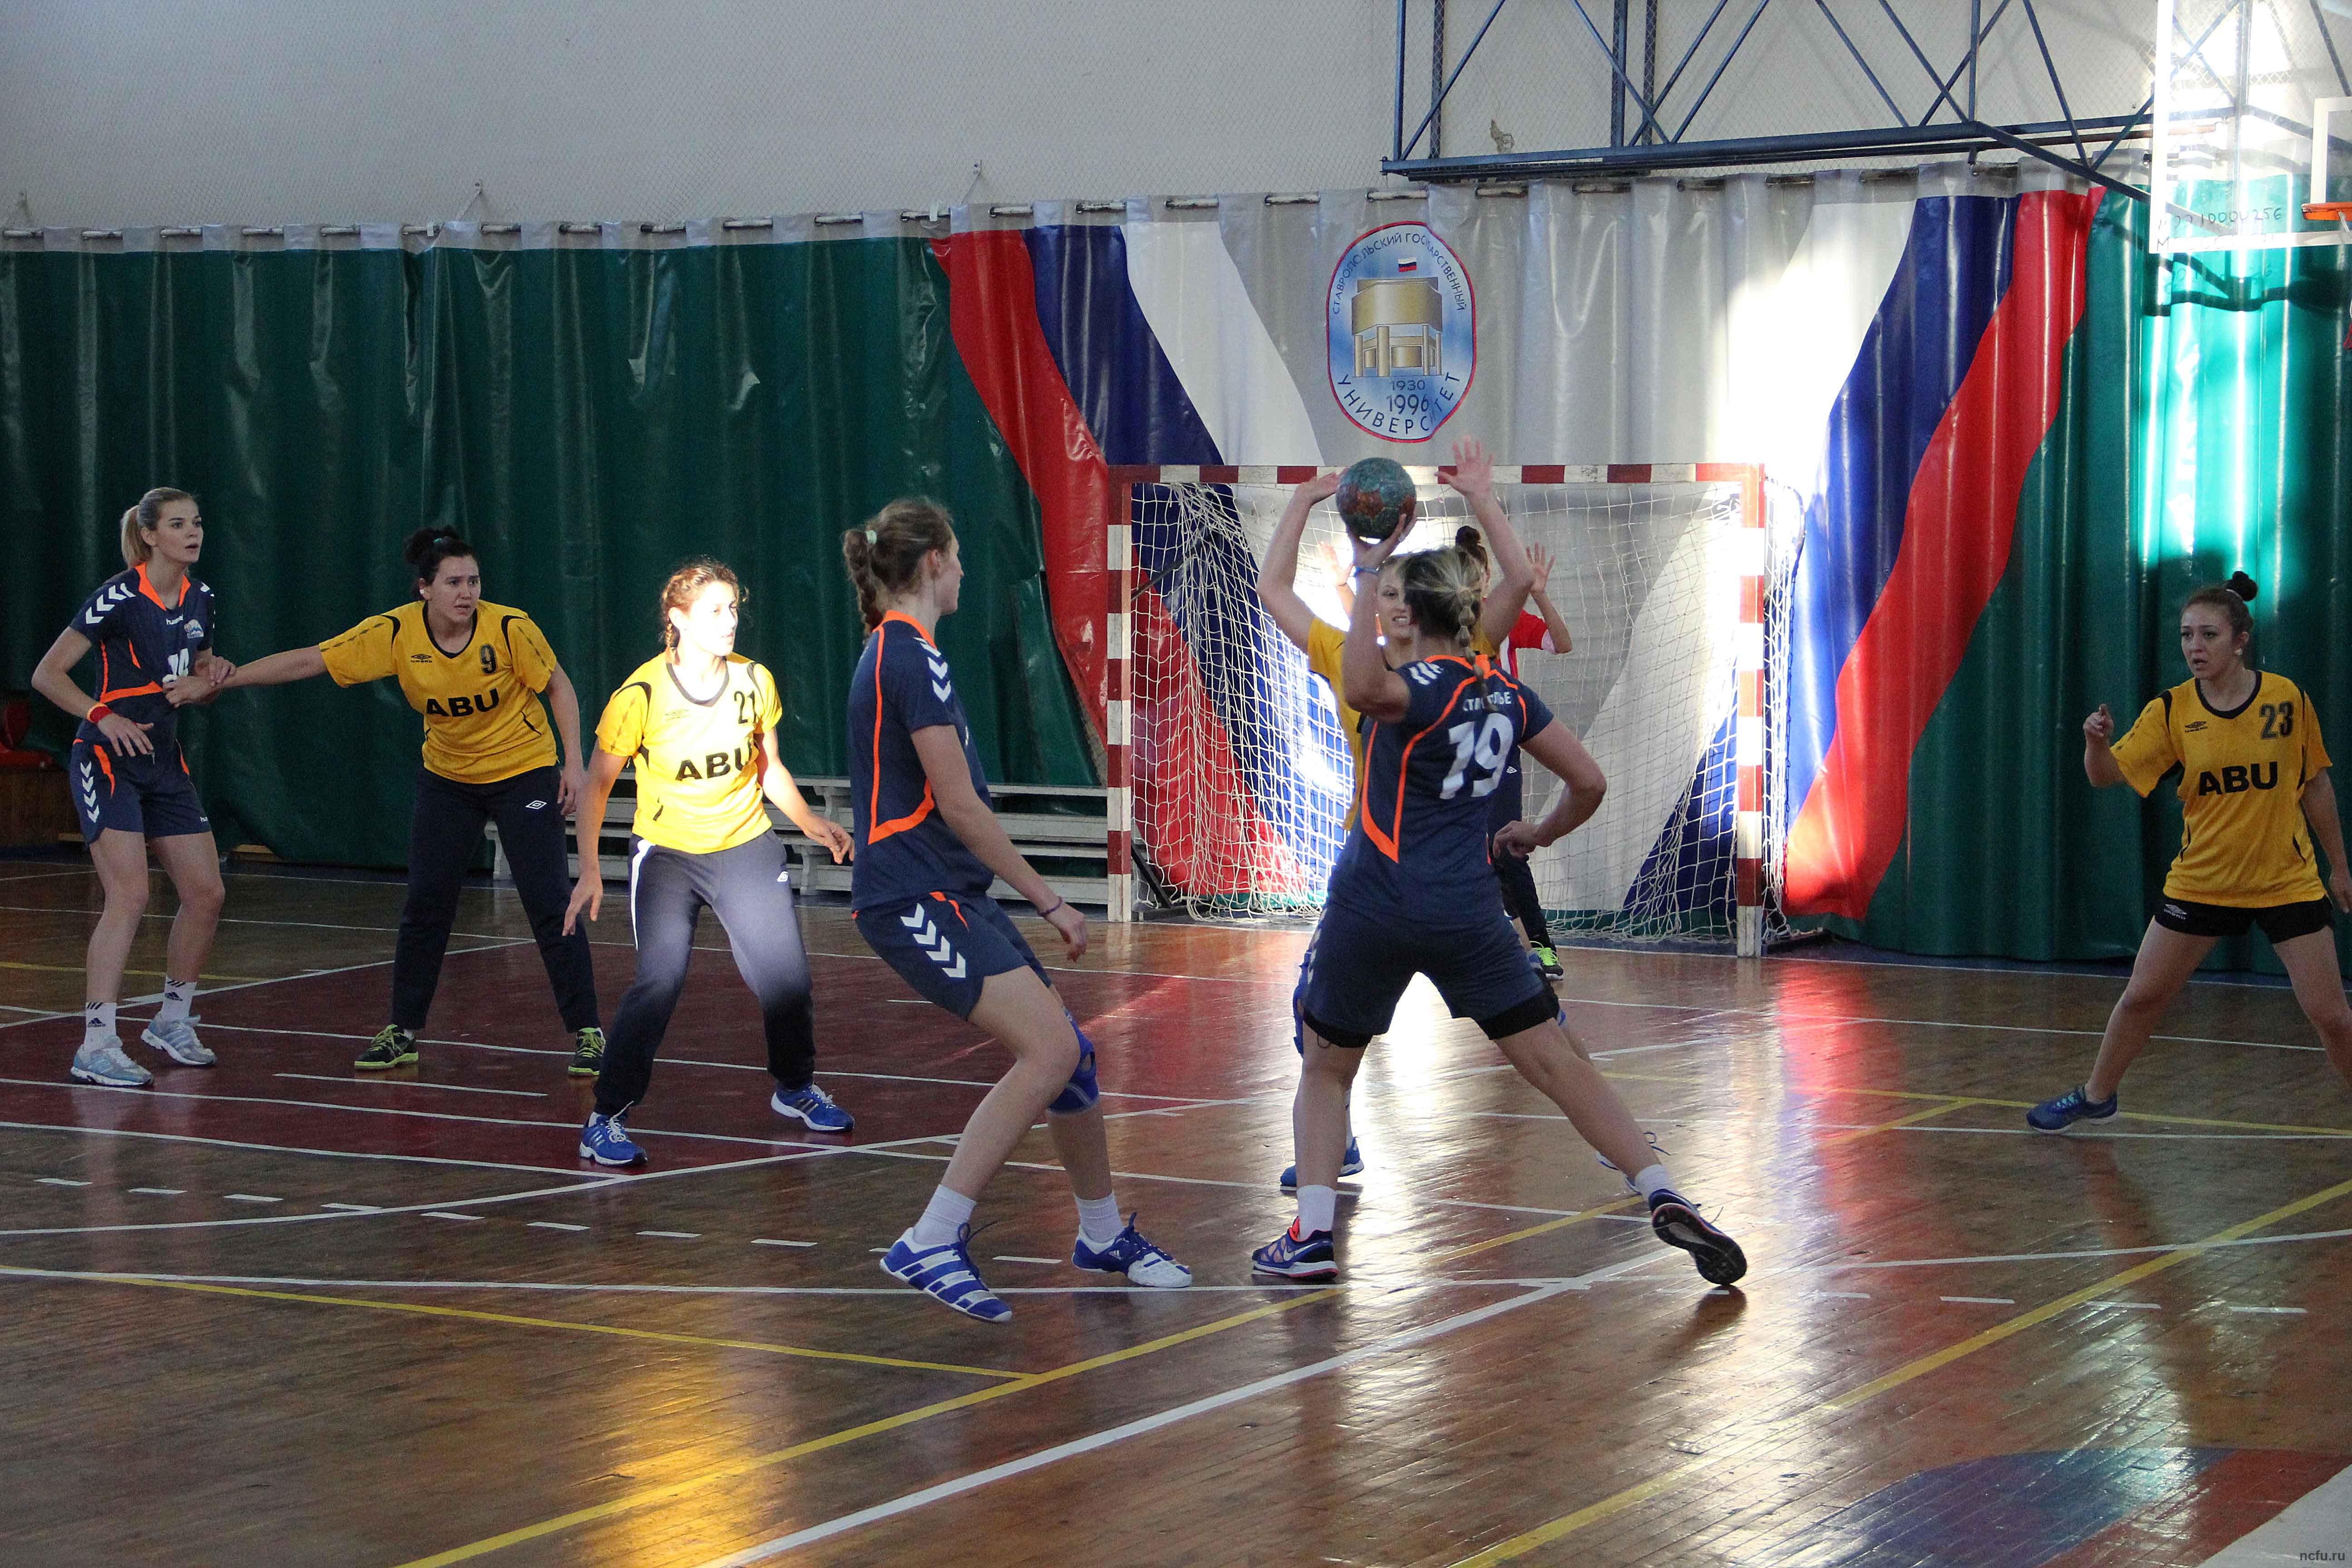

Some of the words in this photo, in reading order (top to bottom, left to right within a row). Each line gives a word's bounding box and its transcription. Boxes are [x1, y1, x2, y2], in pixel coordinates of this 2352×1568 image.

[1333, 232, 1401, 314] СТАВРОПОЛЬСКИЙ
[1406, 233, 1467, 311] ГОСАРСТВЕННЫЙ
[1390, 380, 1426, 391] 1930
[1386, 394, 1429, 415] 1996
[479, 643, 497, 675] 9
[426, 688, 500, 717] ABU
[734, 690, 756, 725] 21
[2259, 701, 2294, 740] 23
[675, 739, 752, 781] ABU
[1439, 712, 1514, 800] 19
[2198, 761, 2278, 796] ABU
